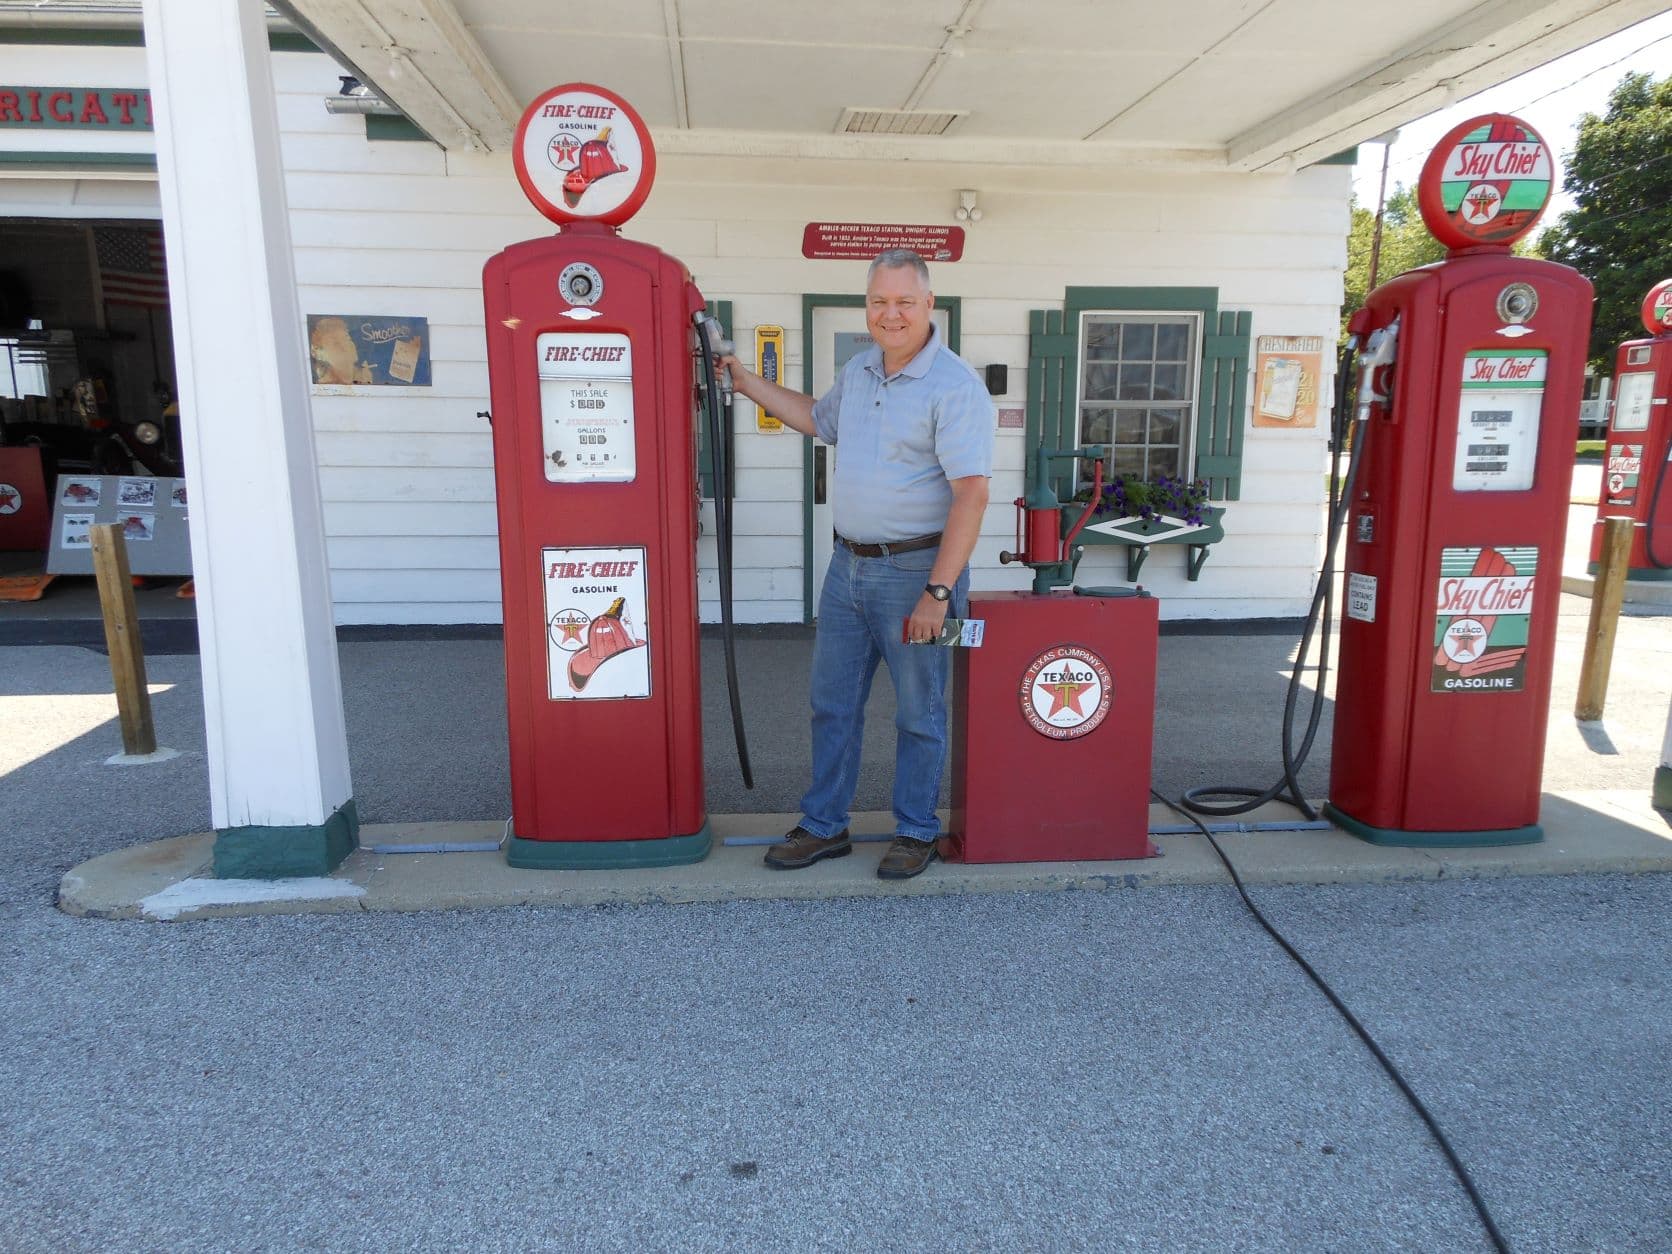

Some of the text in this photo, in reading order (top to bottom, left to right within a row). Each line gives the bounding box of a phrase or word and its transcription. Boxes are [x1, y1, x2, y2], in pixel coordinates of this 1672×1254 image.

[542, 104, 616, 120] FIRE-CHIEF
[558, 122, 598, 130] GASOLINE
[1454, 143, 1542, 180] Sky Chief
[861, 225, 880, 233] TEXACO
[928, 227, 949, 235] ILLINOIS
[545, 346, 626, 362] FIRE-CHIEF
[1470, 357, 1536, 382] Sky Chief
[571, 389, 608, 398] THIS SALE
[549, 561, 638, 578] FIRE-CHIEF
[572, 586, 618, 594] GASOLINE
[1438, 578, 1535, 616] Sky Chief
[1022, 677, 1033, 693] THE
[1029, 652, 1056, 674] TEXAS
[1057, 648, 1101, 667] COMPANY
[1043, 672, 1093, 682] TEXACO
[1444, 678, 1514, 688] GASOLINE
[1023, 700, 1109, 737] PETROLEUM PRODUCTS
